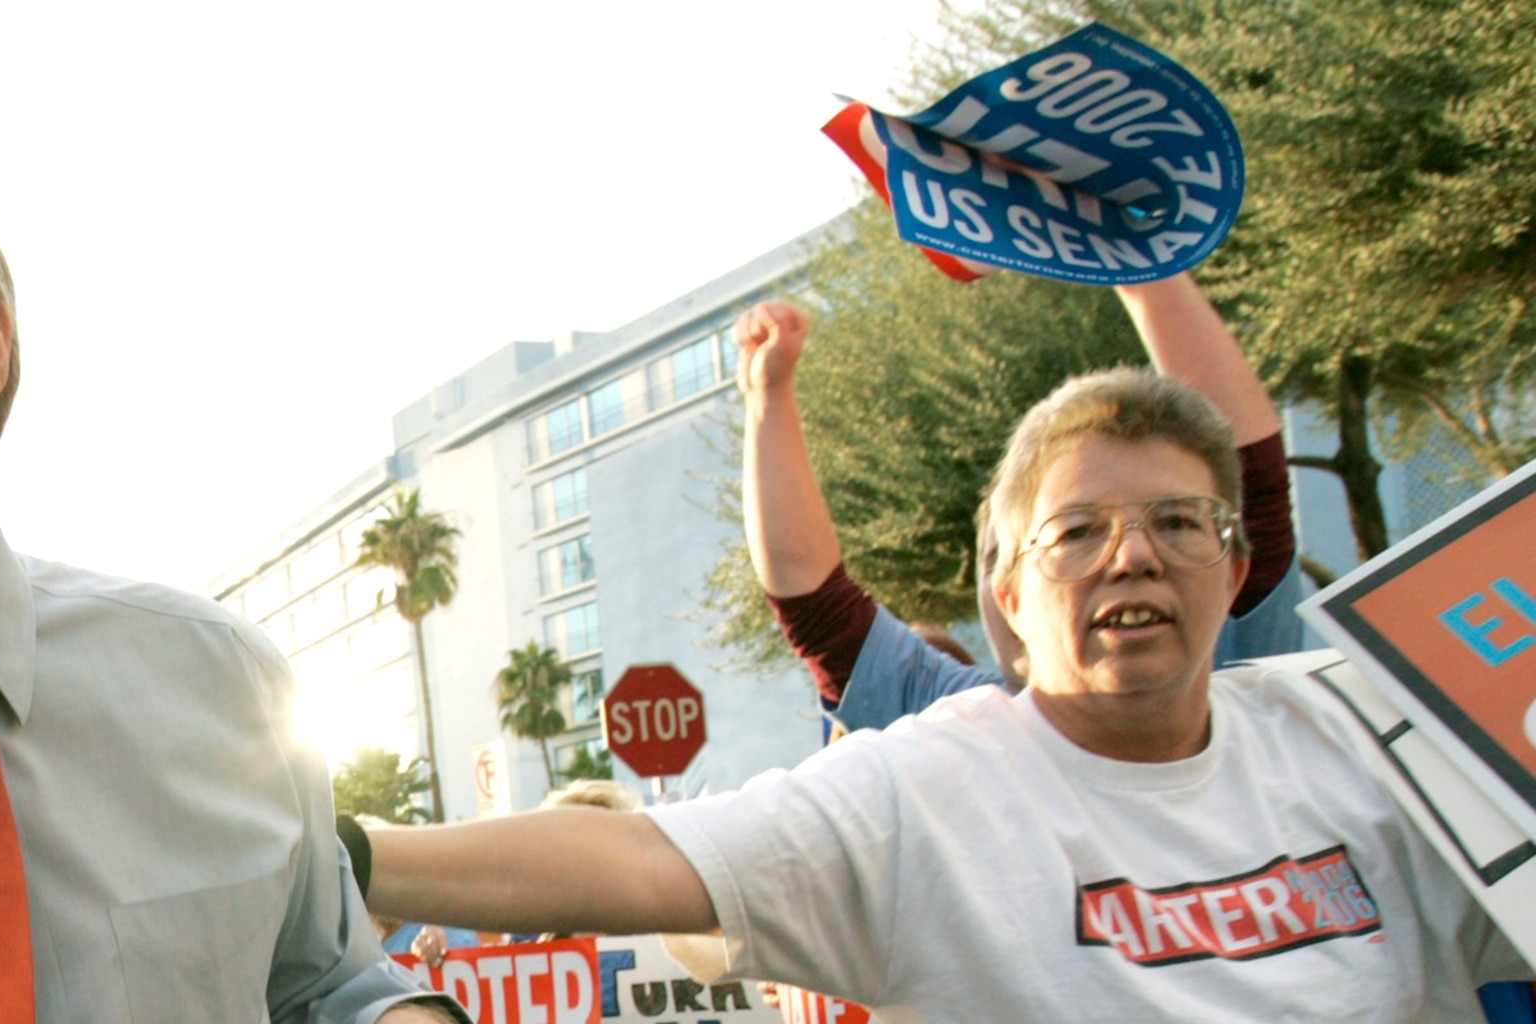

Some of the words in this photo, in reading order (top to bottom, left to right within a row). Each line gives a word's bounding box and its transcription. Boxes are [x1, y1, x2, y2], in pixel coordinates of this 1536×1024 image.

[1000, 53, 1204, 148] 2006
[902, 170, 993, 244] US
[1006, 151, 1222, 271] SENATE
[610, 697, 700, 744] STOP
